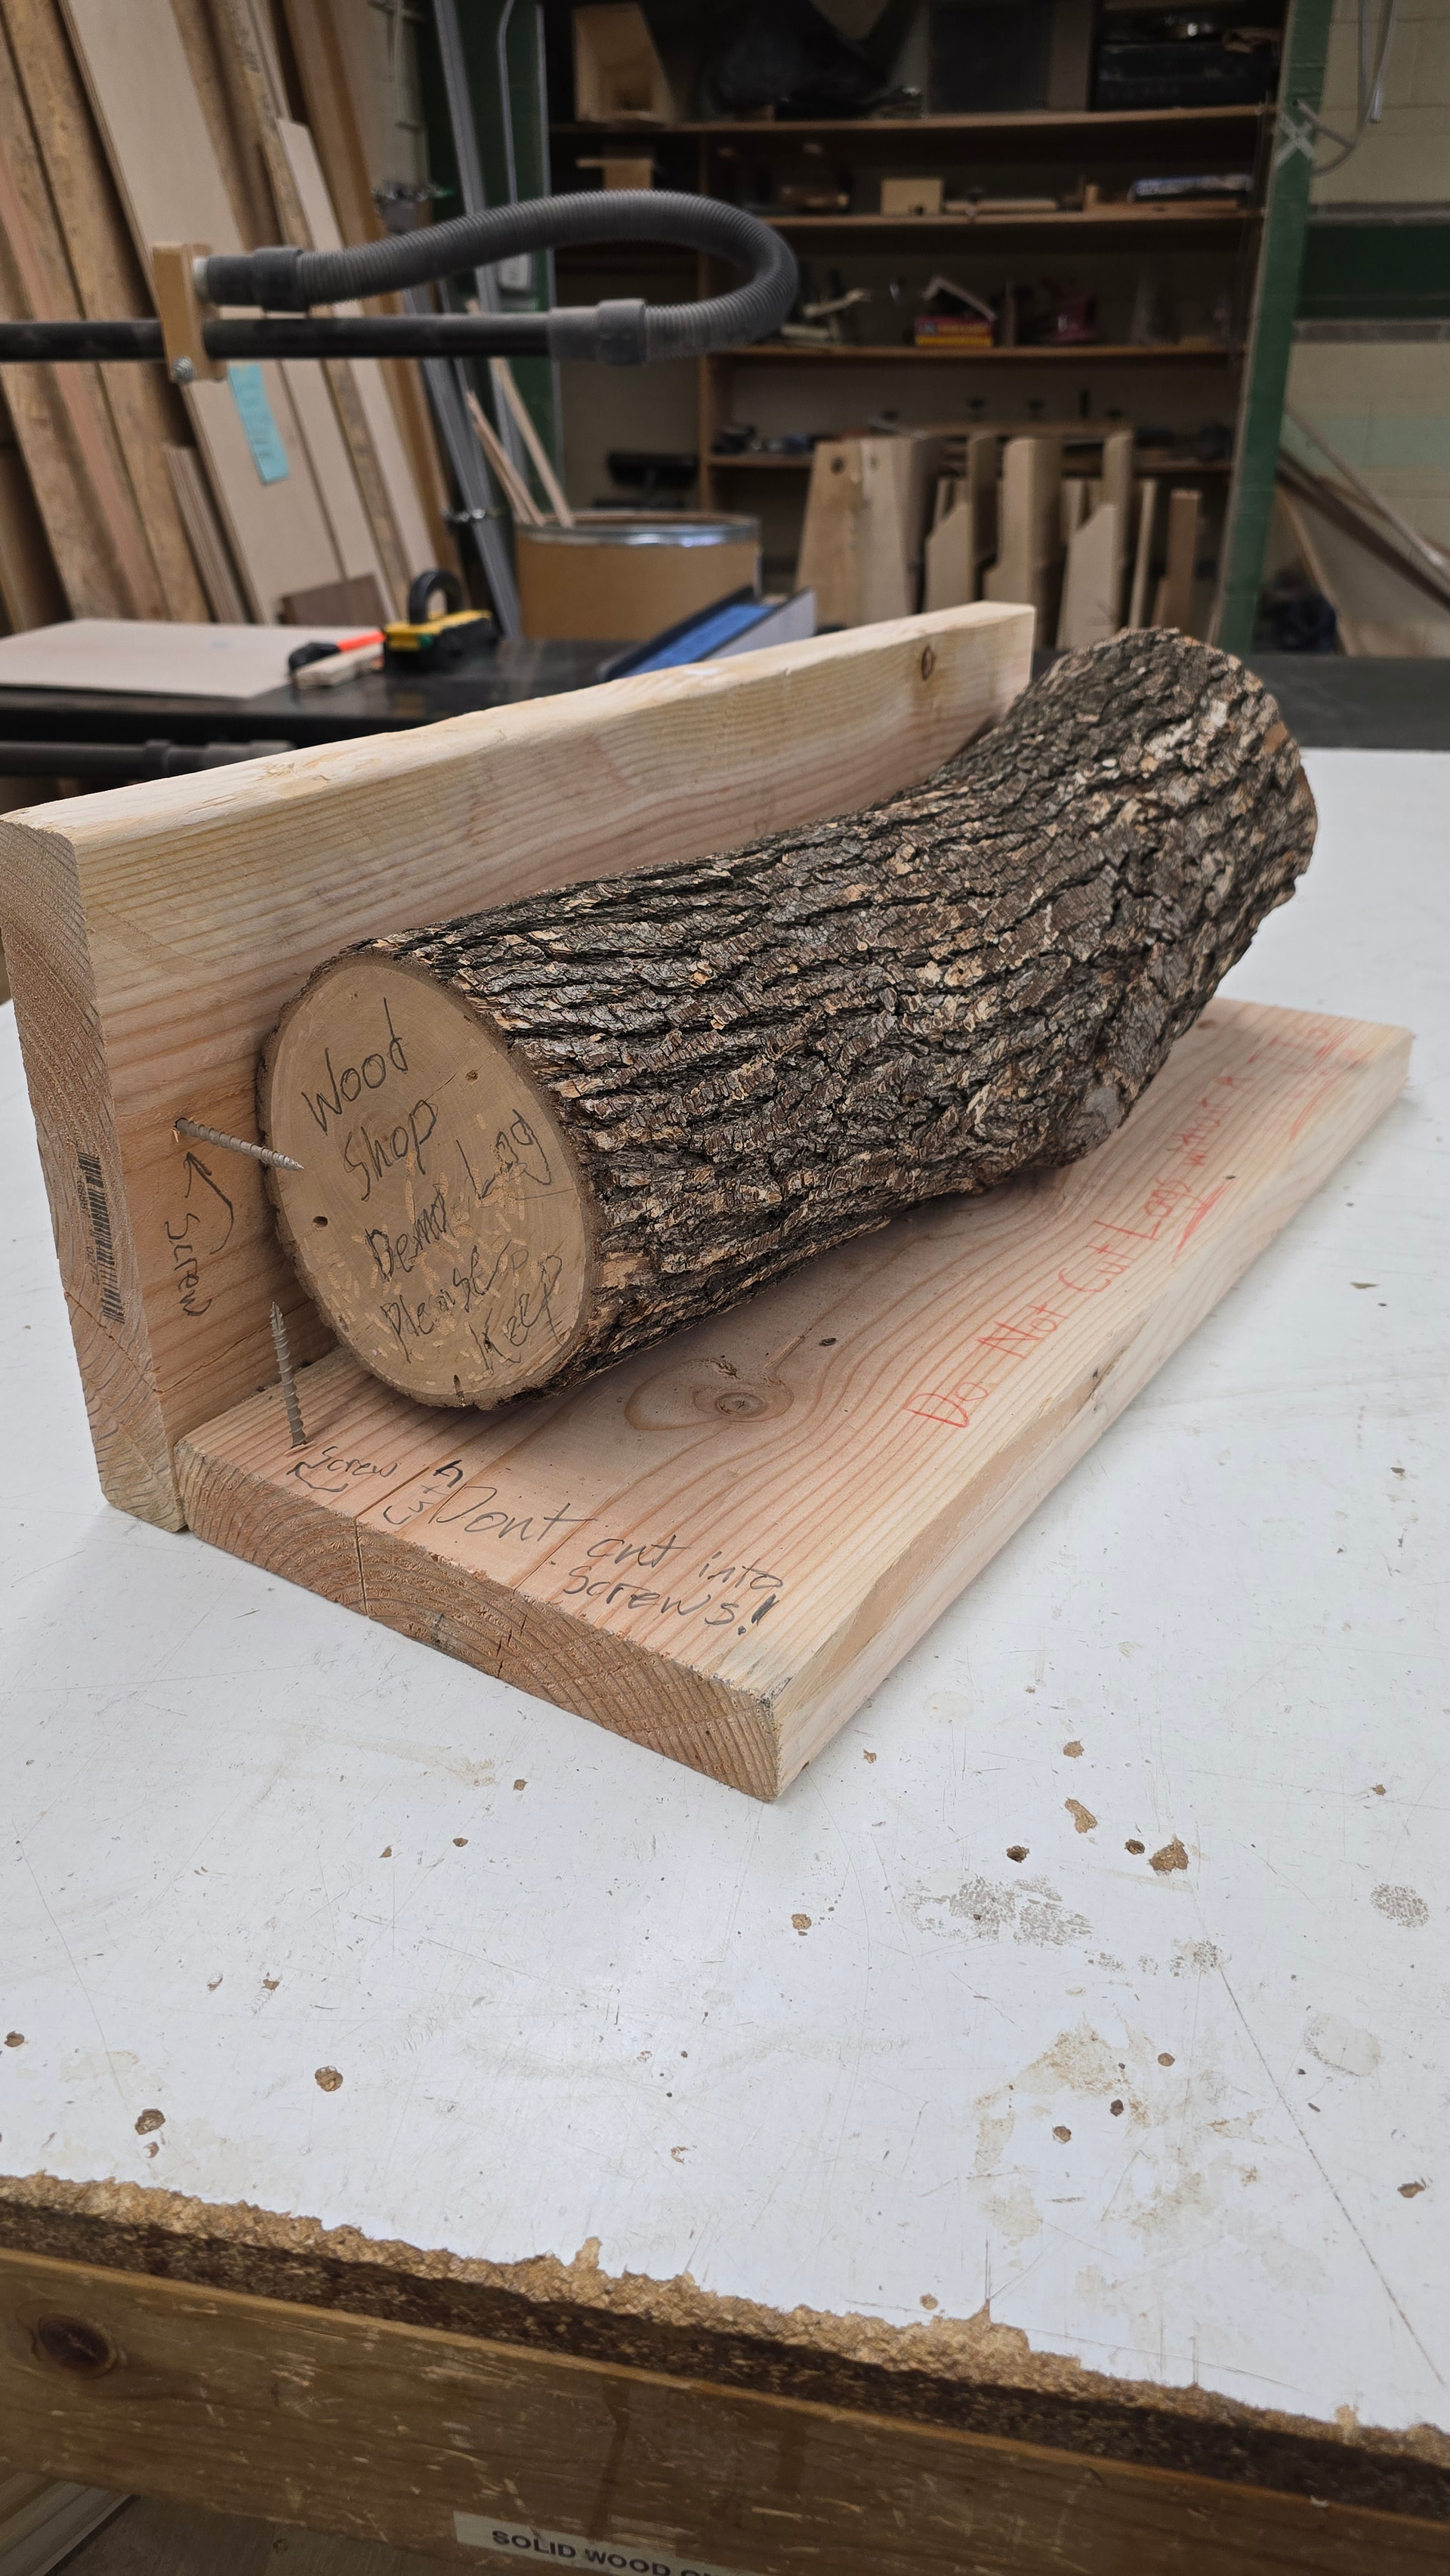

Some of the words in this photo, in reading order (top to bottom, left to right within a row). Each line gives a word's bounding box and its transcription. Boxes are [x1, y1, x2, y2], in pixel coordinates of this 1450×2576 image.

[302, 997, 409, 1135] Wood
[343, 1100, 439, 1202] Shop
[365, 1186, 448, 1282] Demo
[456, 1108, 553, 1203] Log
[1094, 1176, 1199, 1242] Logs
[1057, 1243, 1137, 1293] Cut
[976, 1302, 1069, 1360] Not
[903, 1380, 989, 1429] Do
[427, 1485, 599, 1543] Dont
[698, 1551, 784, 1591] into
[492, 2530, 577, 2559] SOLID
[584, 2547, 672, 2576] WOOD
